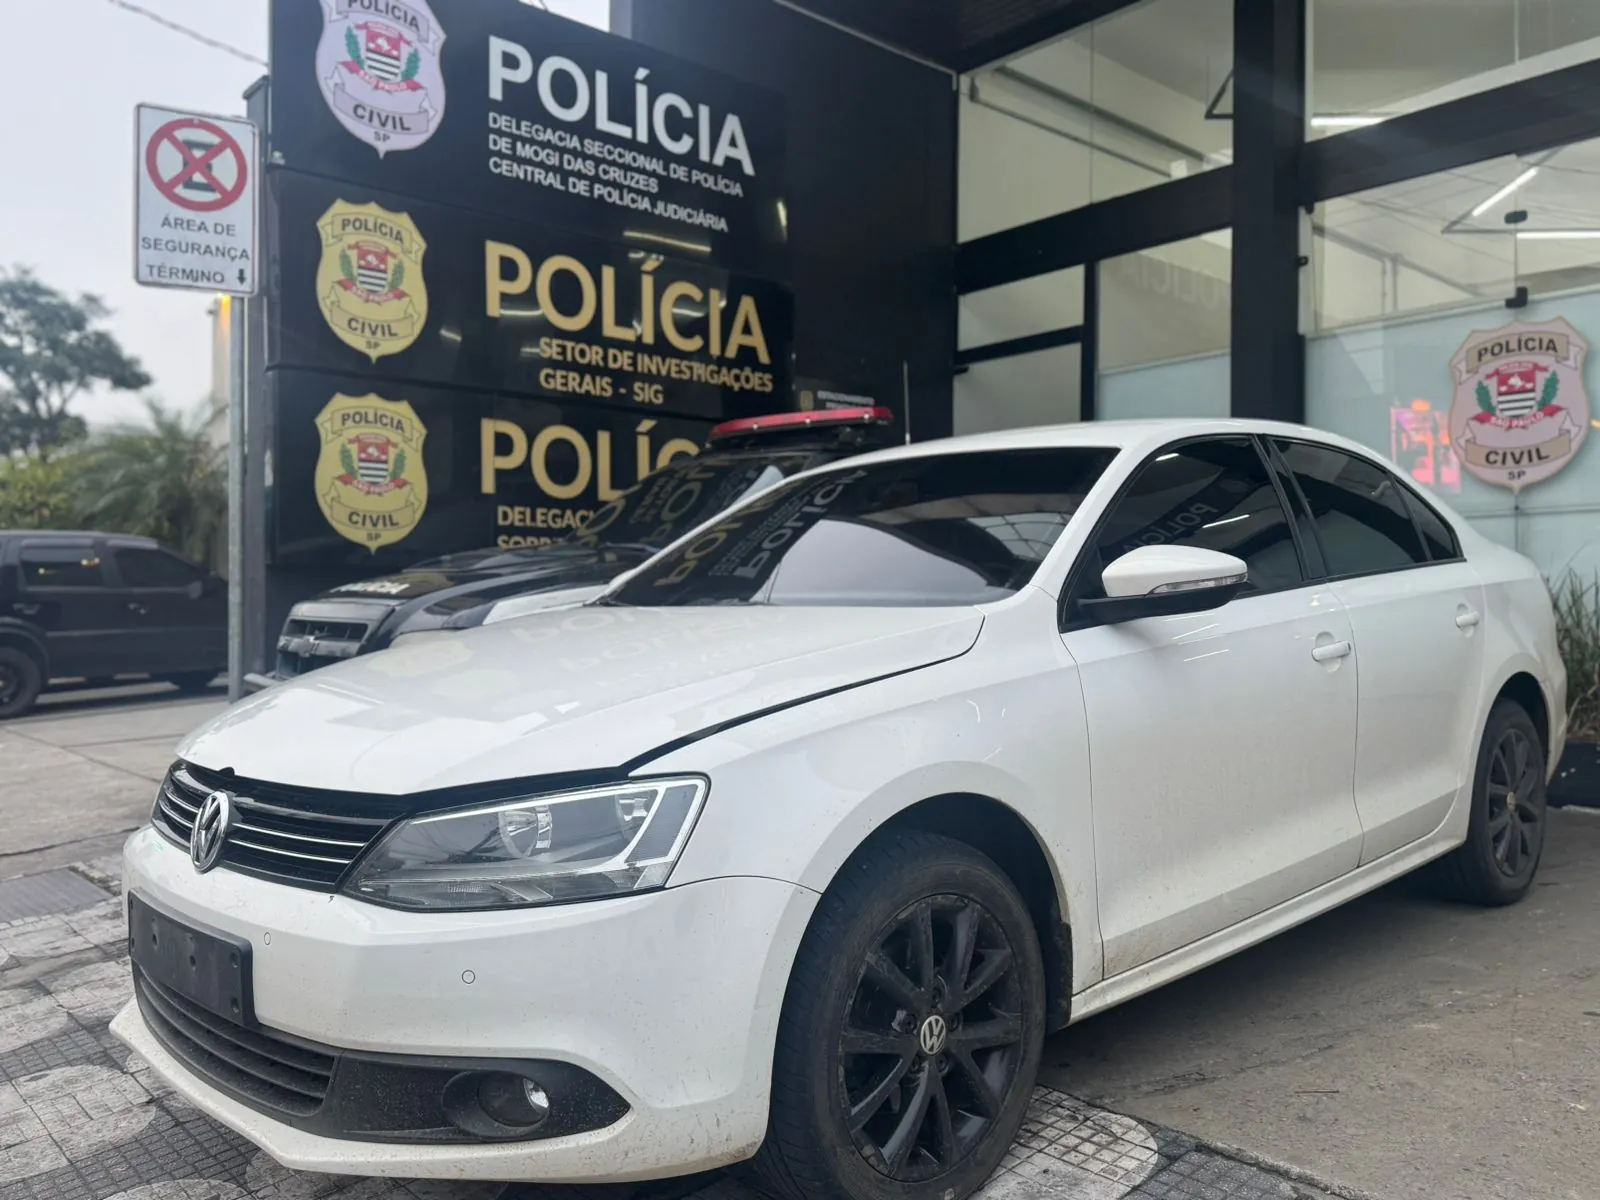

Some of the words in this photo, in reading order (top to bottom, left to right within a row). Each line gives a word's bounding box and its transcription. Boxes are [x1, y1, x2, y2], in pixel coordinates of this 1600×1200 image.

[353, 104, 411, 132] CIVIL
[489, 35, 755, 177] POLÍCIA
[373, 131, 391, 142] SP
[488, 112, 581, 151] DELEGACIA
[583, 138, 667, 176] SECCIONAL
[669, 162, 689, 182] DE
[691, 169, 744, 197] POLÍCIA
[488, 134, 512, 154] DE
[516, 141, 560, 167] MOGI
[563, 153, 595, 176] DAS
[598, 163, 659, 194] CRUZES
[489, 156, 566, 191] CENTRAL
[568, 177, 590, 196] DE
[594, 183, 652, 213] POLÍCIA
[653, 200, 729, 233] JUDICIÁRIA
[161, 212, 209, 233] ÁREA
[213, 222, 236, 237] DE
[141, 236, 249, 262] SEGURANÇA
[485, 239, 772, 365] POLÍCIA
[347, 316, 398, 337] CIVIL
[539, 336, 604, 368] SETOR
[607, 348, 634, 372] DE
[637, 354, 774, 393] INVESTIGAÇÕES
[539, 367, 613, 398] GERAIS
[633, 381, 664, 405] SIG
[1485, 447, 1550, 466] CIVIL
[1508, 470, 1526, 481] SP
[348, 511, 399, 527] CIVIL
[497, 505, 596, 529] DELEGAC
[366, 532, 382, 542] SP
